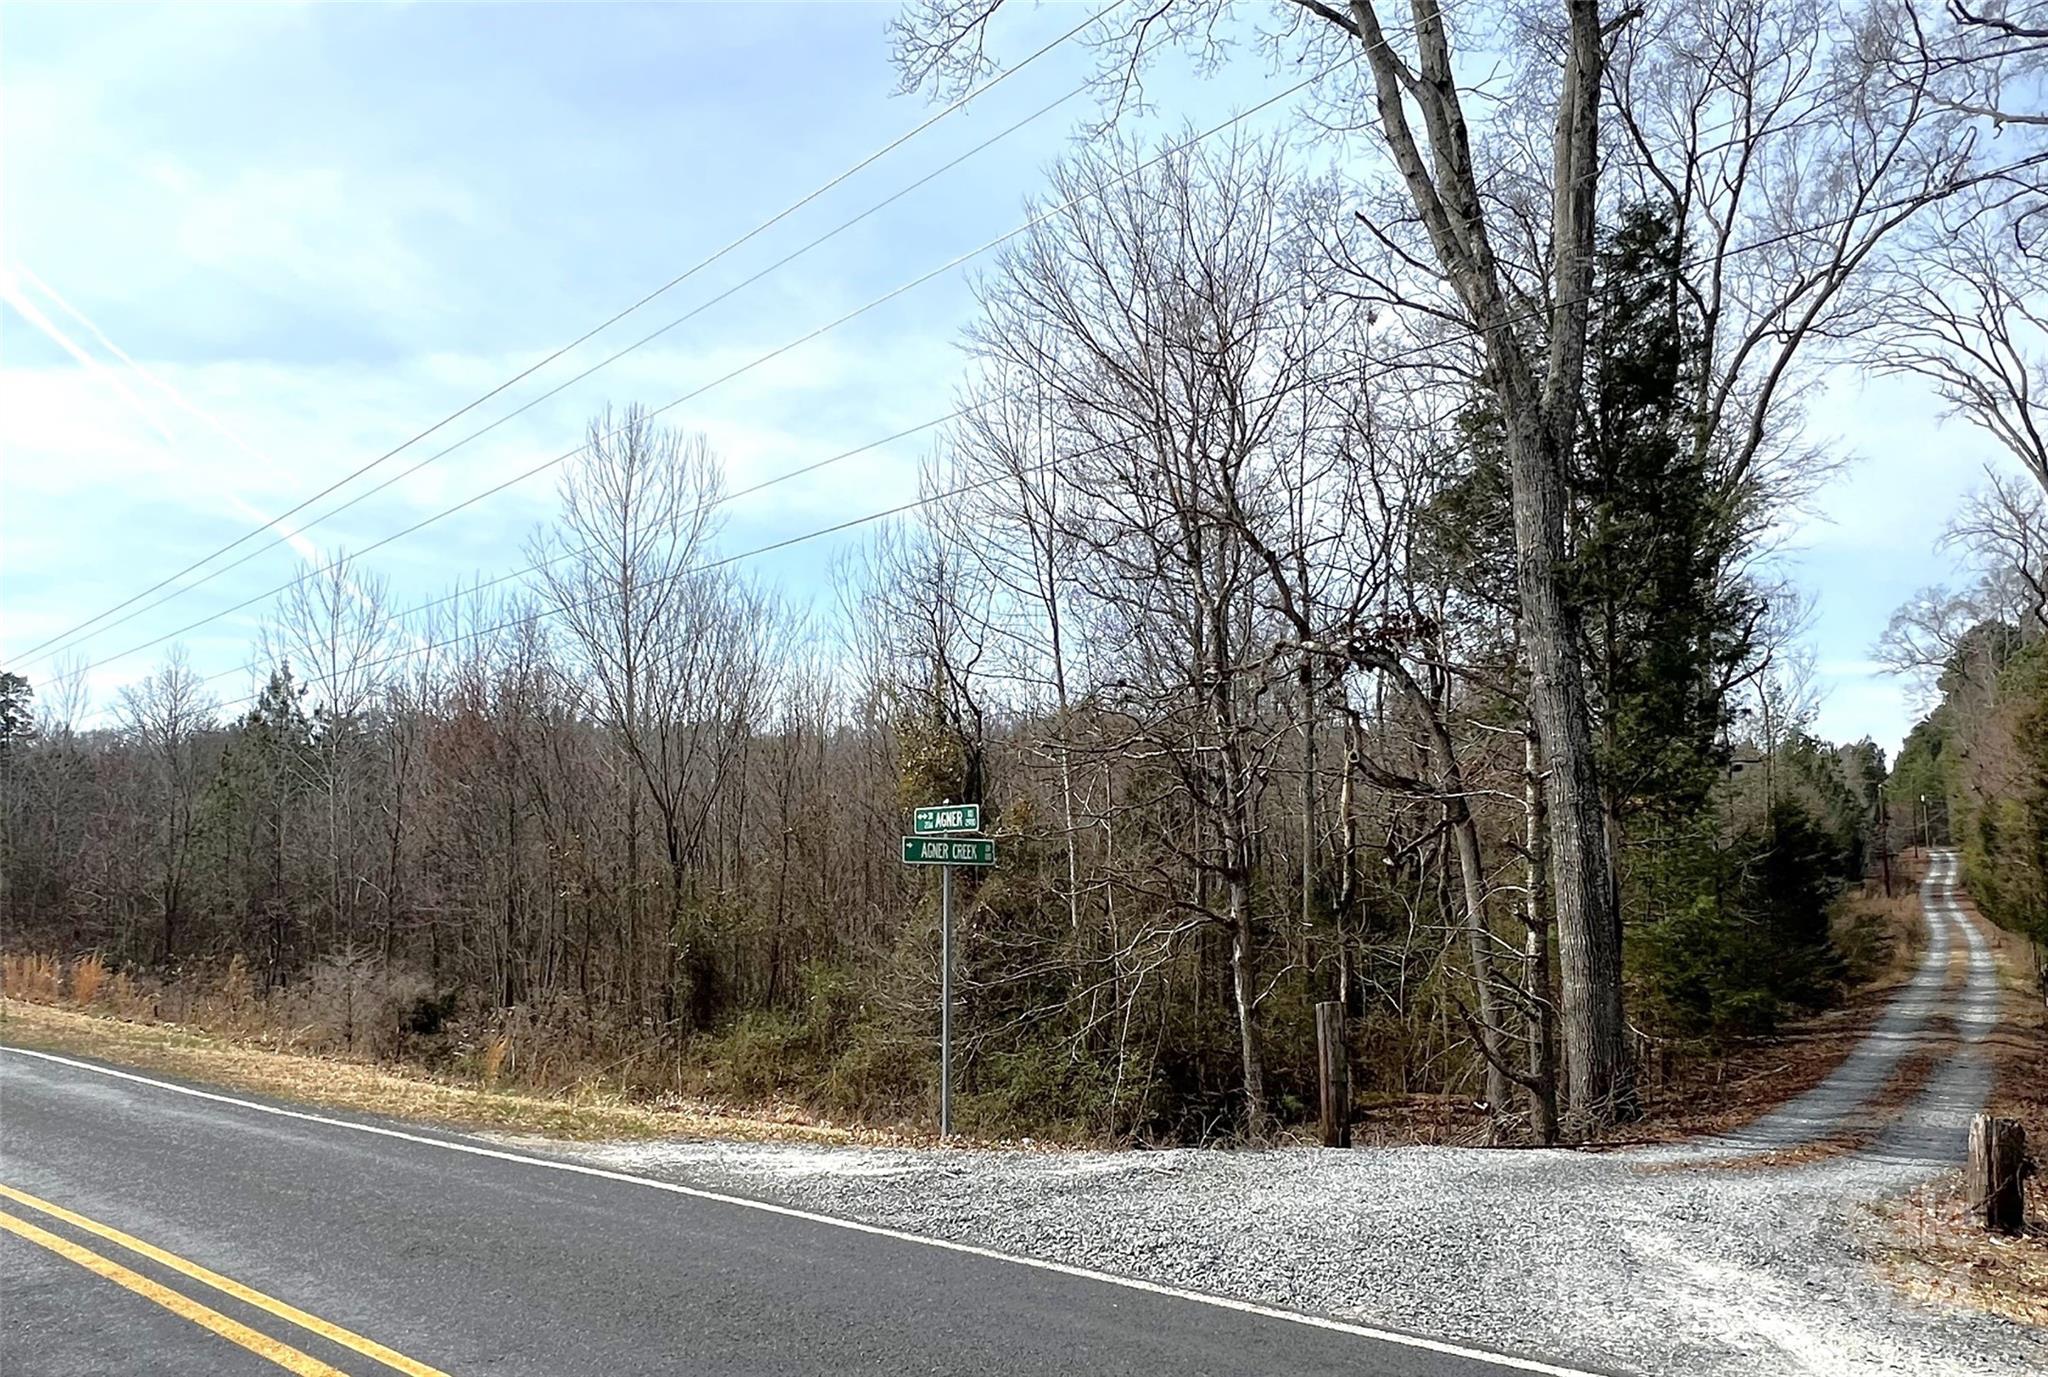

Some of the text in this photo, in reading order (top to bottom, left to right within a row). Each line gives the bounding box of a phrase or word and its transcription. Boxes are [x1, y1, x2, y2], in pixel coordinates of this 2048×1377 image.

[934, 810, 963, 829] AGNER
[920, 842, 949, 859] AGNER
[952, 843, 977, 860] CREEK
